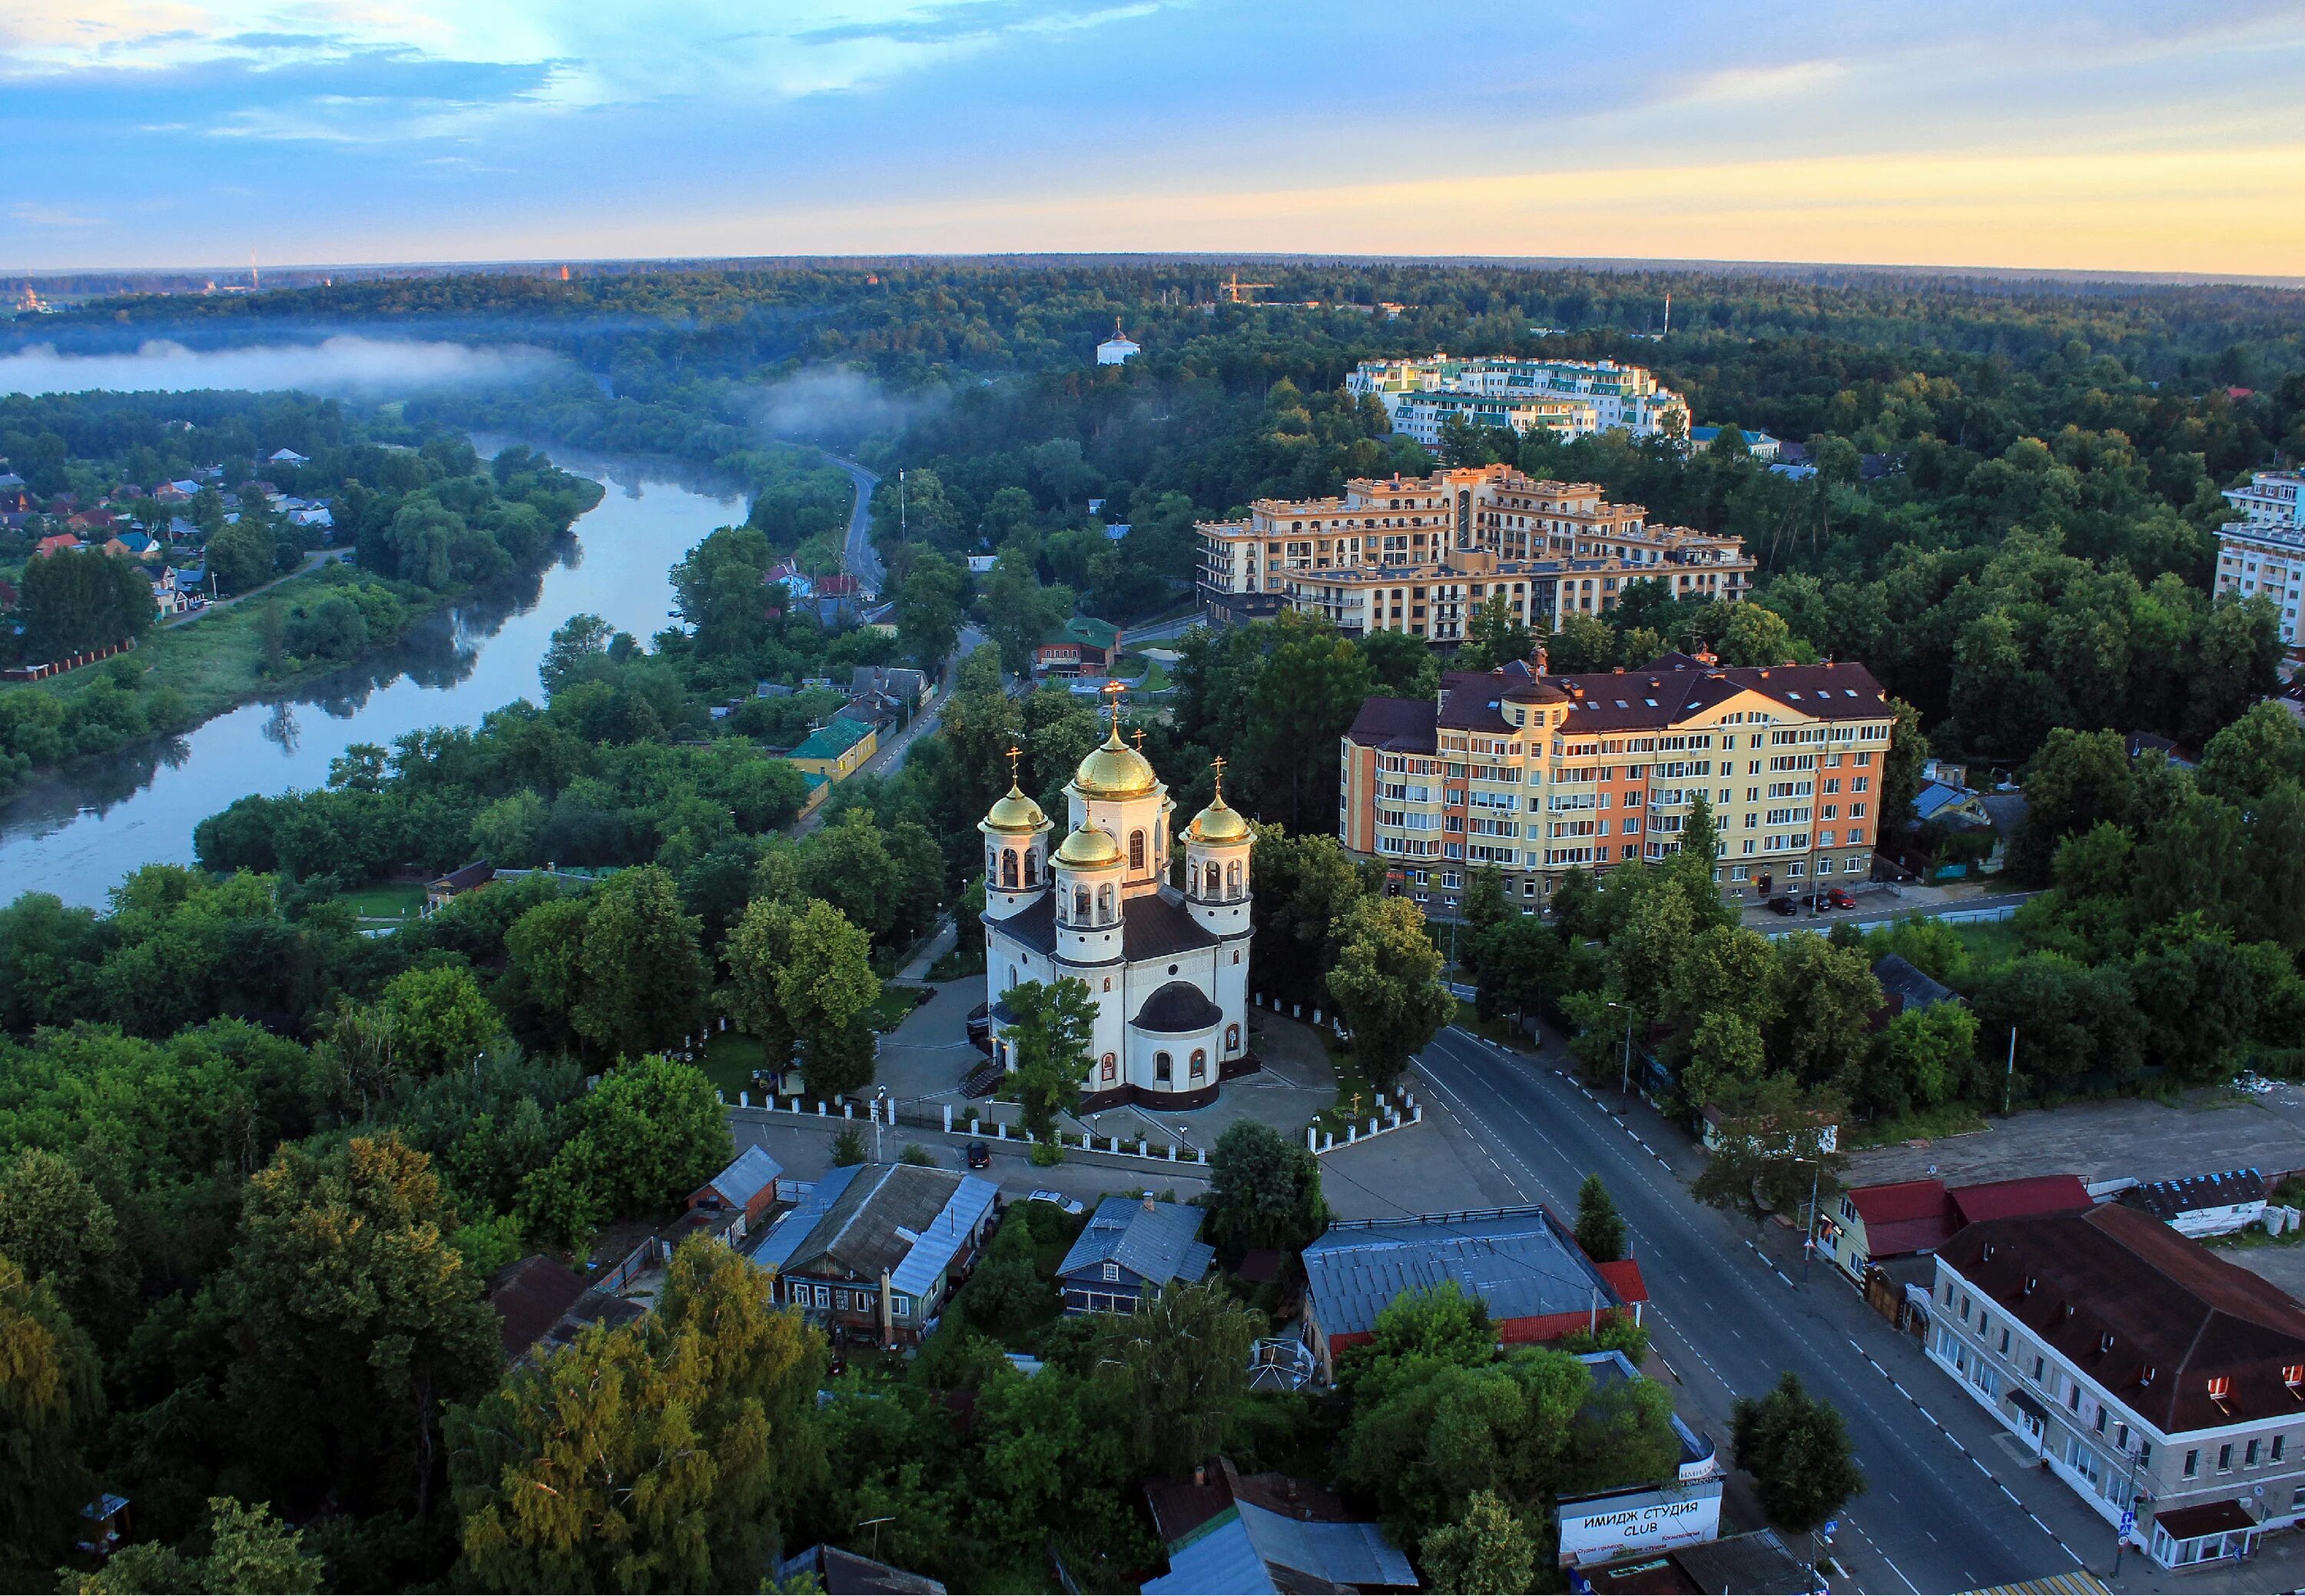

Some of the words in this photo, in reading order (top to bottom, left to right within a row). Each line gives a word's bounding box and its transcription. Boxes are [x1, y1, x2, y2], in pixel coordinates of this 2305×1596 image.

[1584, 1511, 1638, 1528] ИМИДЖ
[1643, 1501, 1698, 1518] СТУДИЯ
[1623, 1522, 1658, 1537] CLUB
